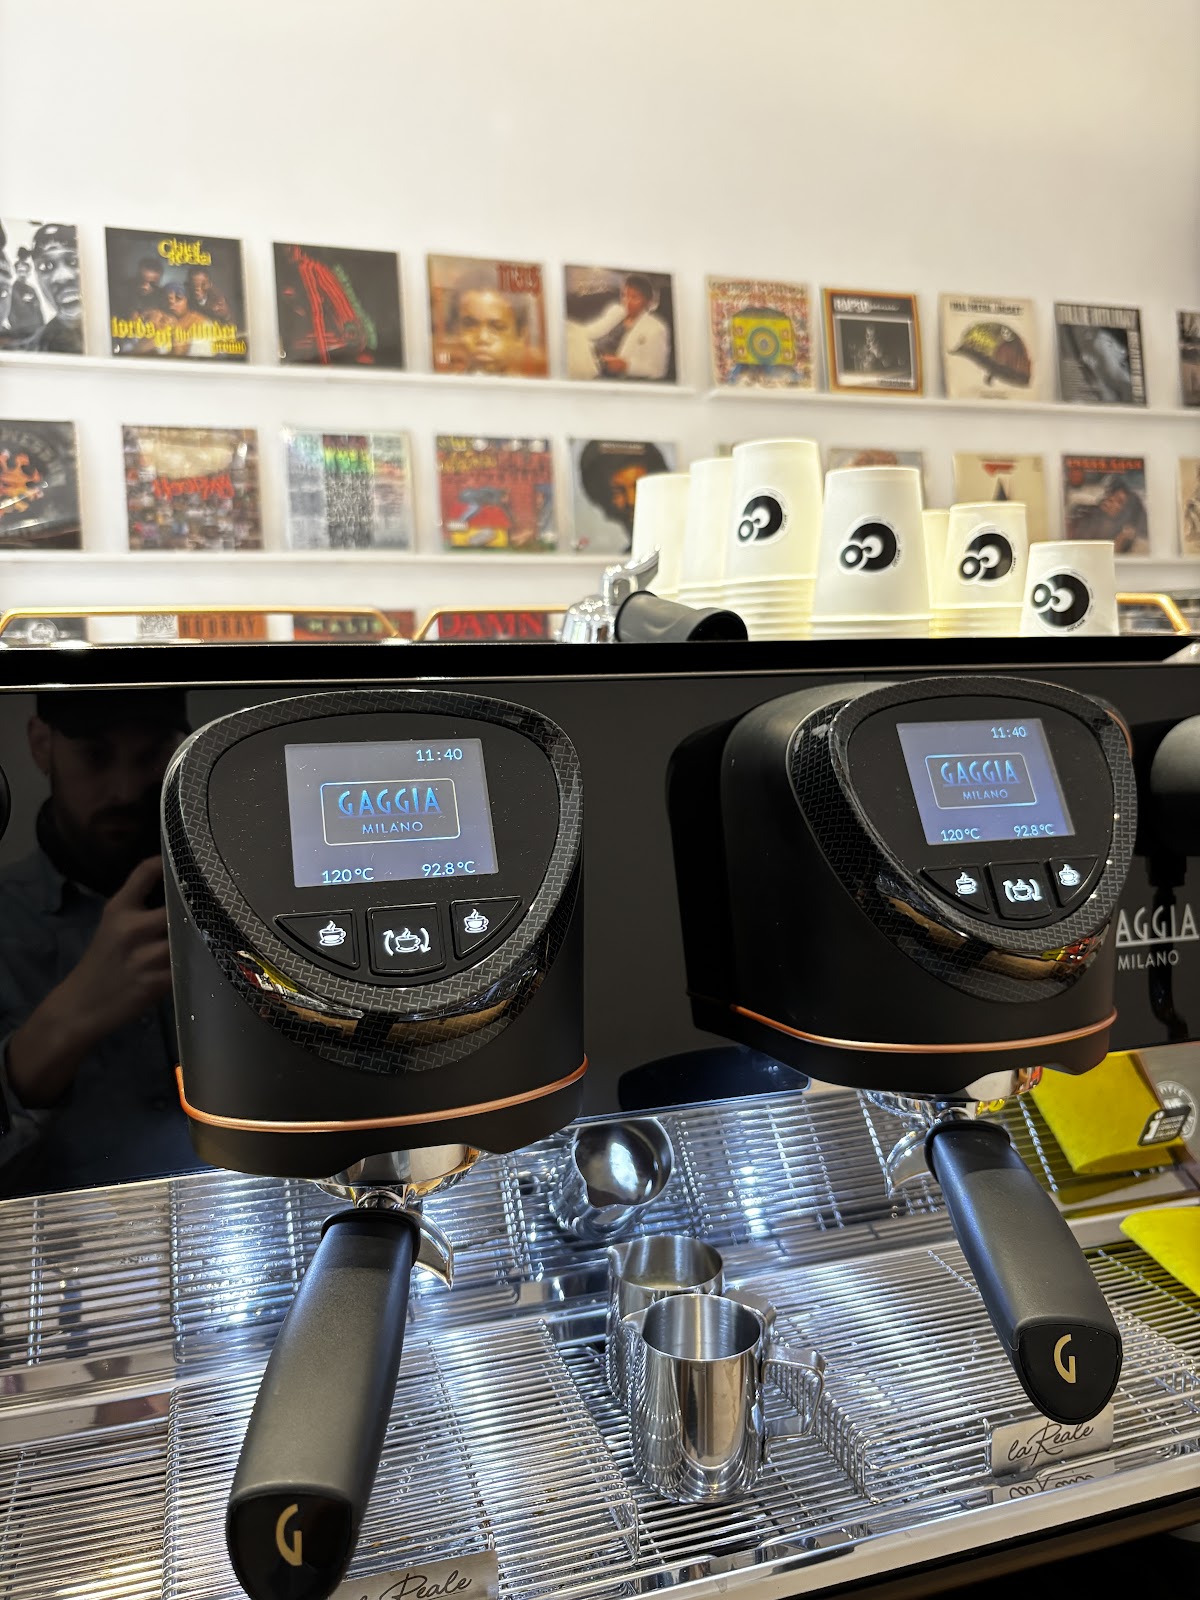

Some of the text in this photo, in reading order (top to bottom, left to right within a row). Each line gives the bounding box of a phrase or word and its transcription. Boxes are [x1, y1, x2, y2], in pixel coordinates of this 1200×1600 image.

[990, 725, 1027, 739] 11:40
[416, 748, 463, 762] 11:40
[940, 759, 1021, 785] GAGGIA
[337, 787, 442, 817] GAGGIA
[963, 789, 1008, 801] MILANO
[361, 821, 424, 835] MILANO
[1115, 903, 1199, 948] AGGIA
[1118, 949, 1179, 971] MILANO
[1053, 1333, 1076, 1384] G
[275, 1503, 303, 1567] G
